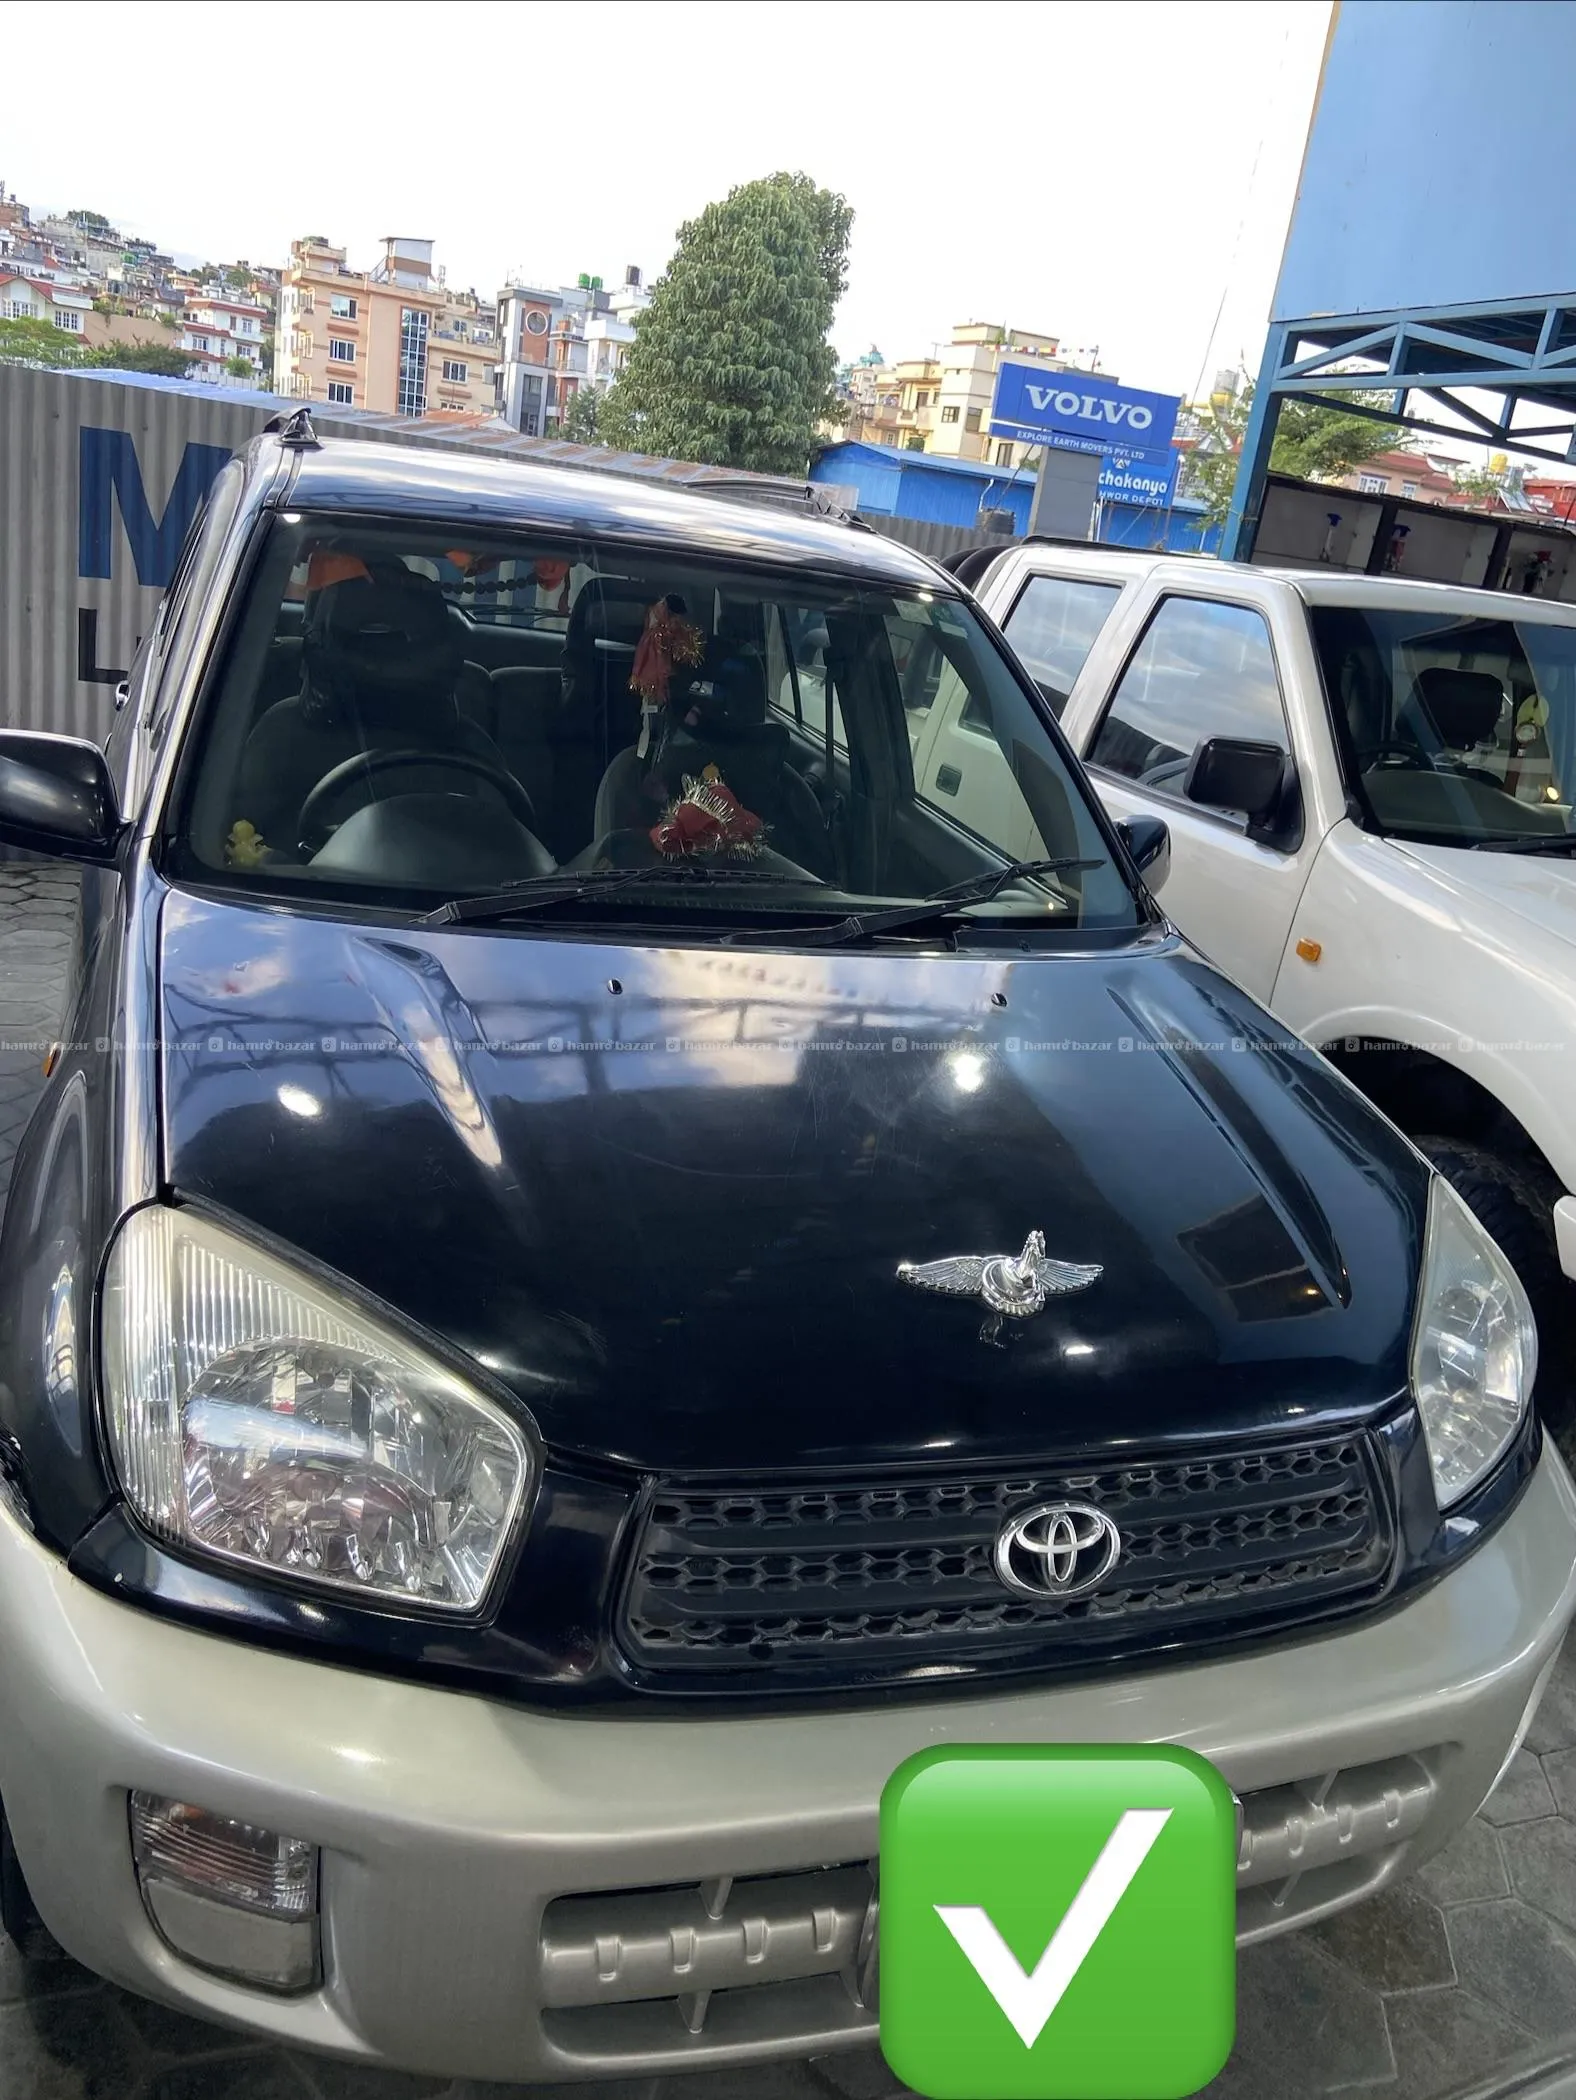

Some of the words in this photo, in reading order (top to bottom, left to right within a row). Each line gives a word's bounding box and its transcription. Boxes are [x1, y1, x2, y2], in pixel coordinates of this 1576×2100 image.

[1025, 384, 1153, 430] VOLVO
[1016, 430, 1052, 443] EXPLORE
[1054, 437, 1080, 449] EARTH
[1081, 441, 1113, 455] MOVERS
[1131, 451, 1145, 460] LTD
[1132, 495, 1164, 506] DEPOT
